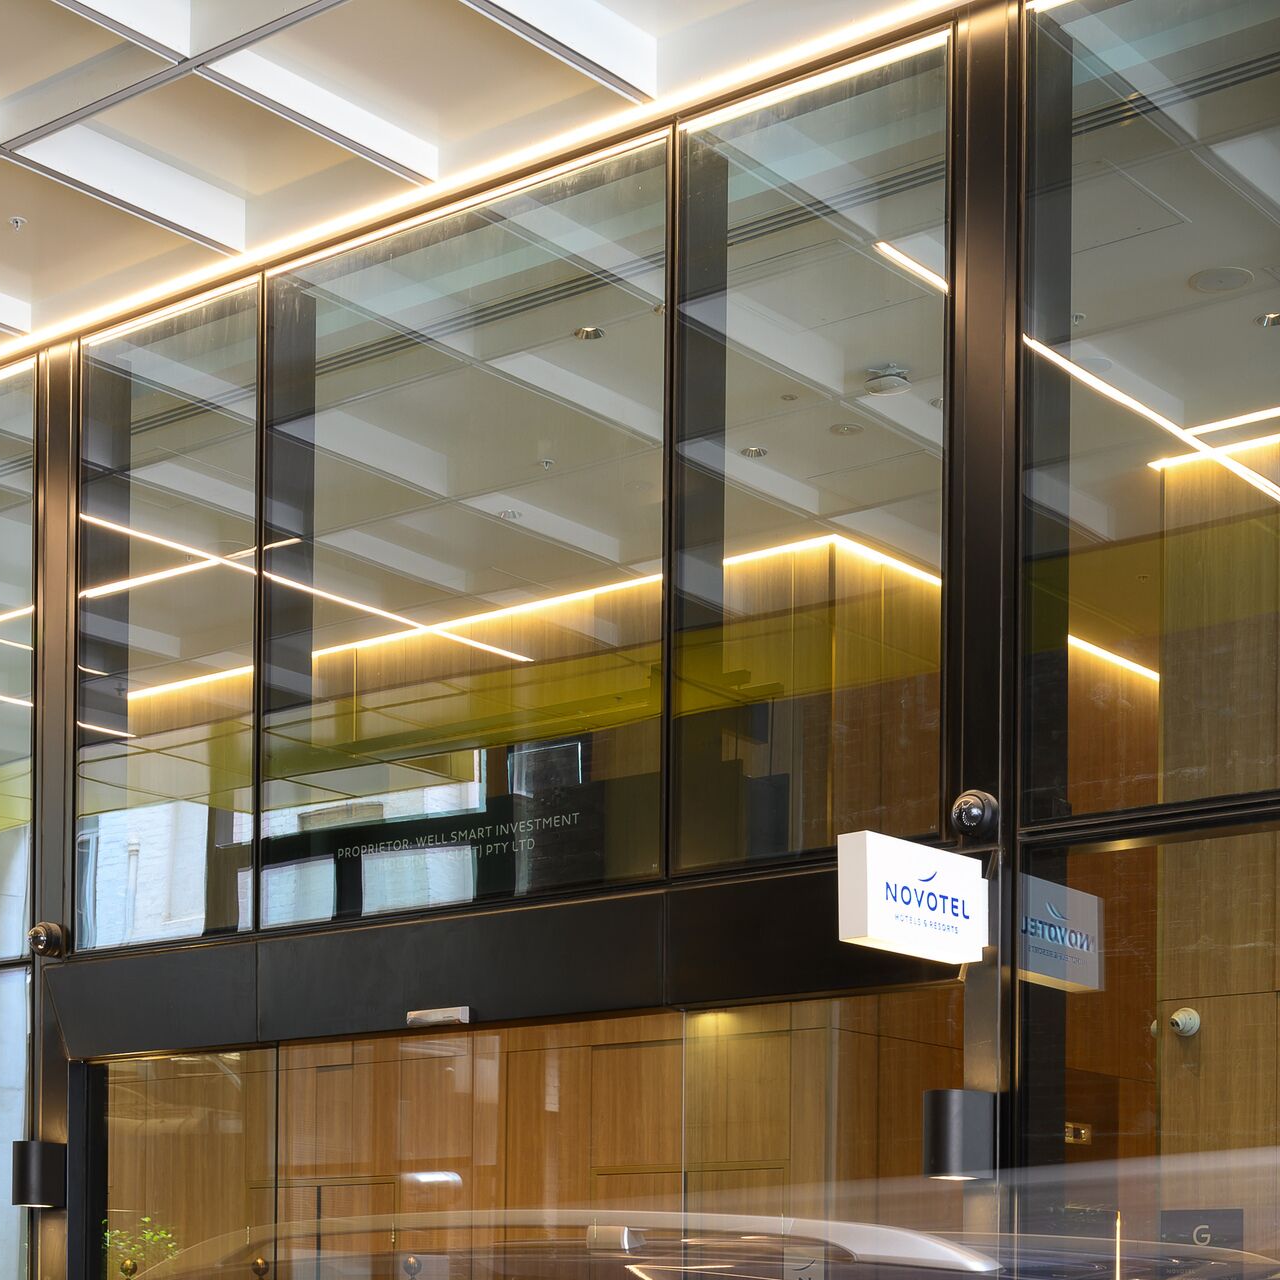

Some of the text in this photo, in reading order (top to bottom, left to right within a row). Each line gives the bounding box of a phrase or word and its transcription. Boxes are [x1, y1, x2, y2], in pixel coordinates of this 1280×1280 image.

[337, 813, 580, 860] PROPRIETOR: WELL SMART INVESTMENT
[486, 842, 510, 856] PTY
[513, 838, 535, 853] LTD
[885, 881, 970, 920] NOVOTEL
[895, 914, 921, 926] HOTELS
[1192, 1225, 1211, 1246] G
